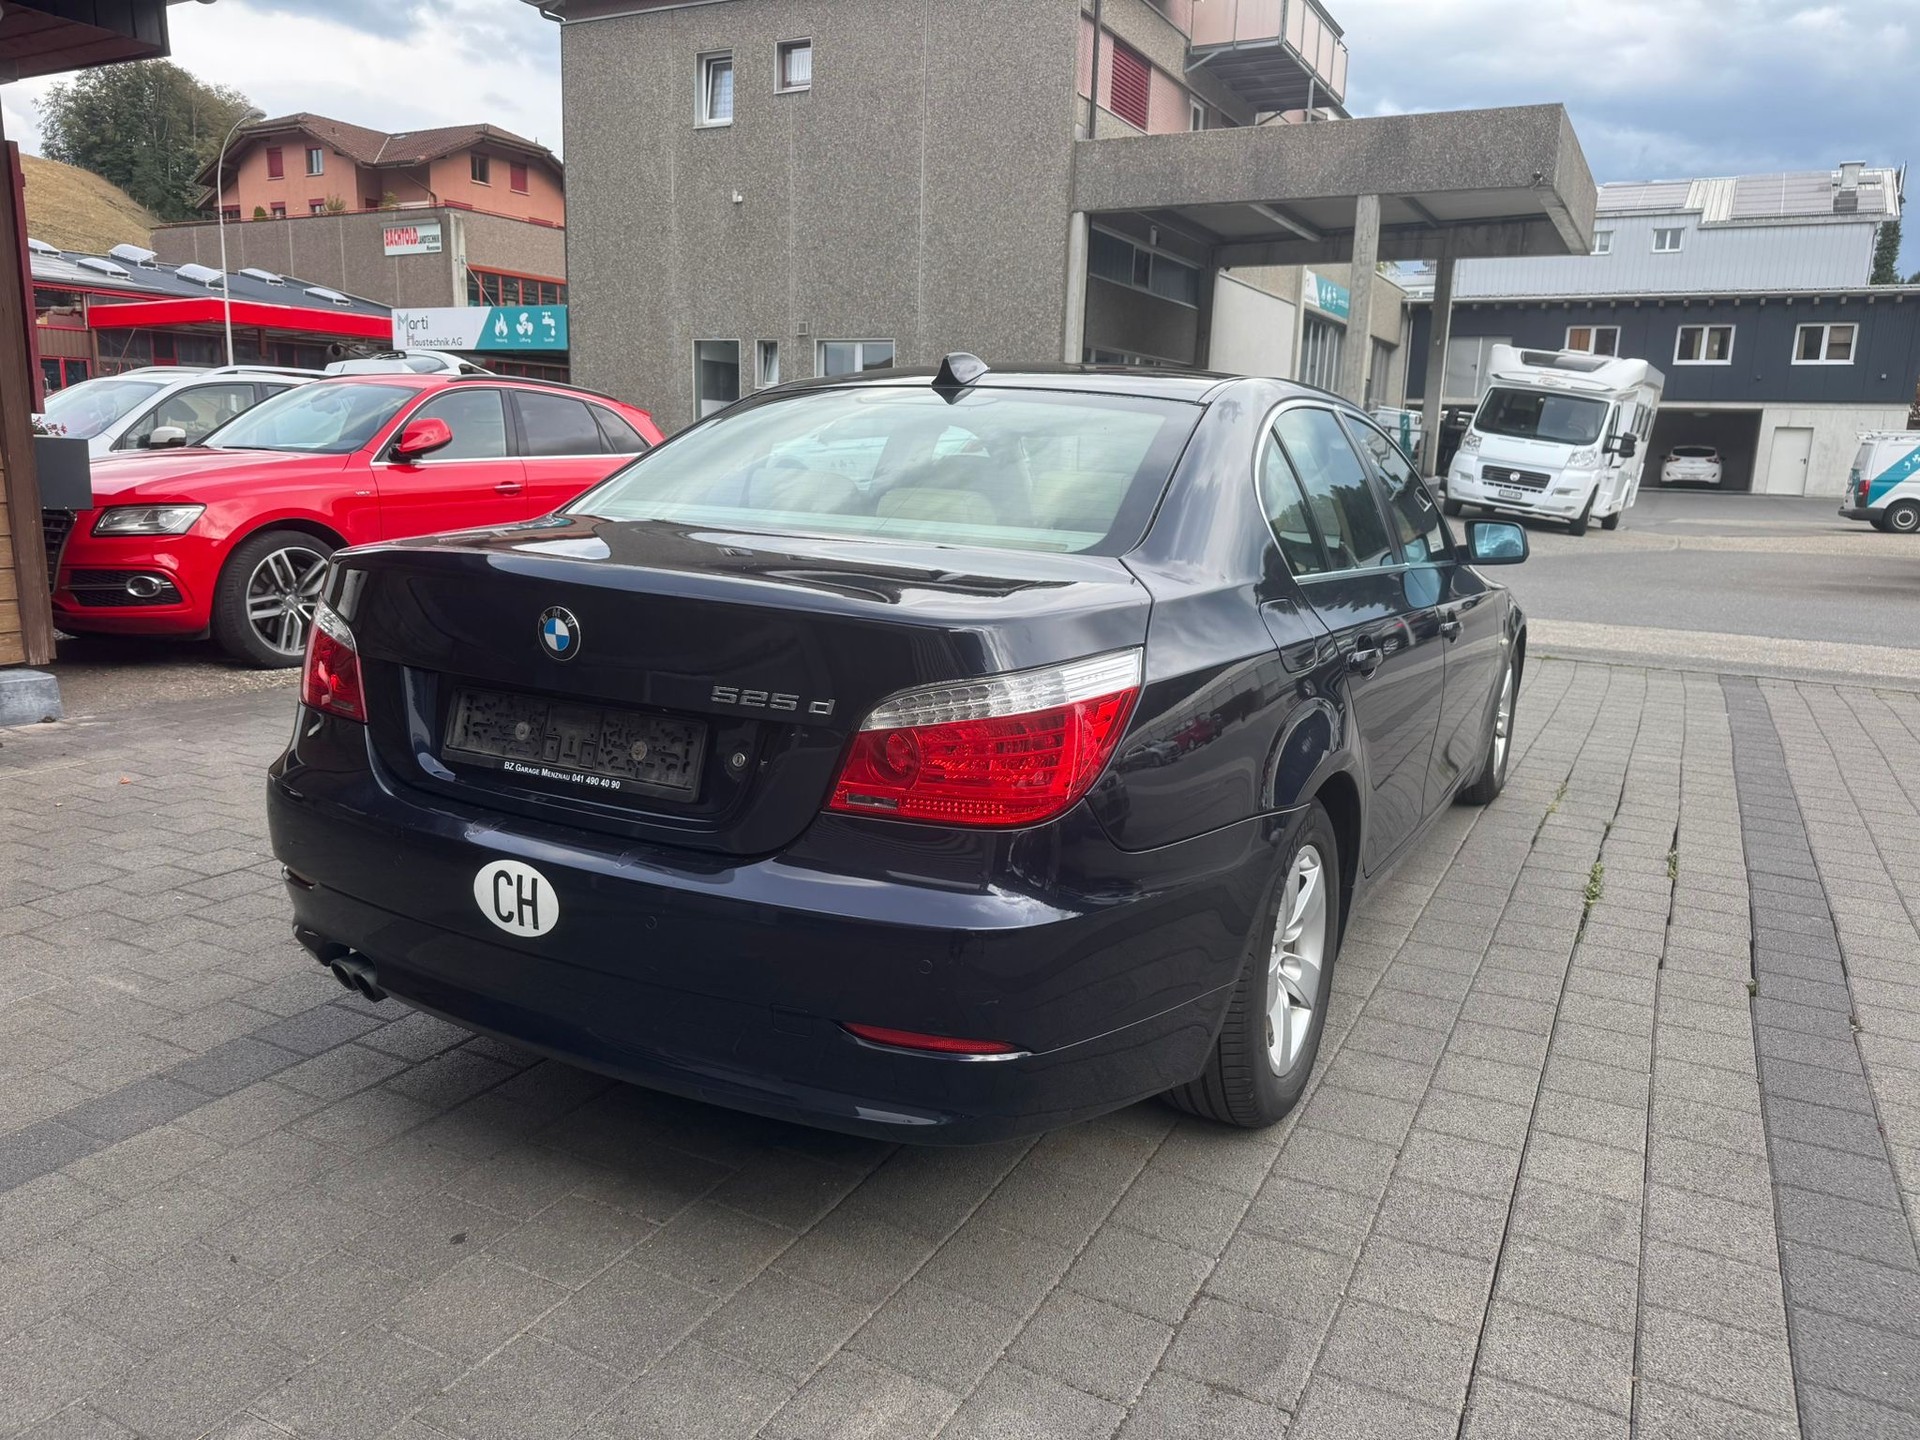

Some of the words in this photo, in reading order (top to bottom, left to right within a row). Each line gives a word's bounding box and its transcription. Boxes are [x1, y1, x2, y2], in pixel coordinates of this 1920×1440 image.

[397, 312, 429, 331] Marti
[406, 334, 449, 347] Haustechnik
[450, 336, 463, 346] AG
[541, 608, 576, 628] BMW
[710, 685, 800, 711] 525
[808, 698, 836, 716] d
[504, 761, 515, 771] BZ
[571, 773, 584, 783] 041
[585, 776, 600, 786] 490
[600, 778, 610, 788] 40
[610, 780, 621, 789] 90
[493, 869, 540, 931] CH
